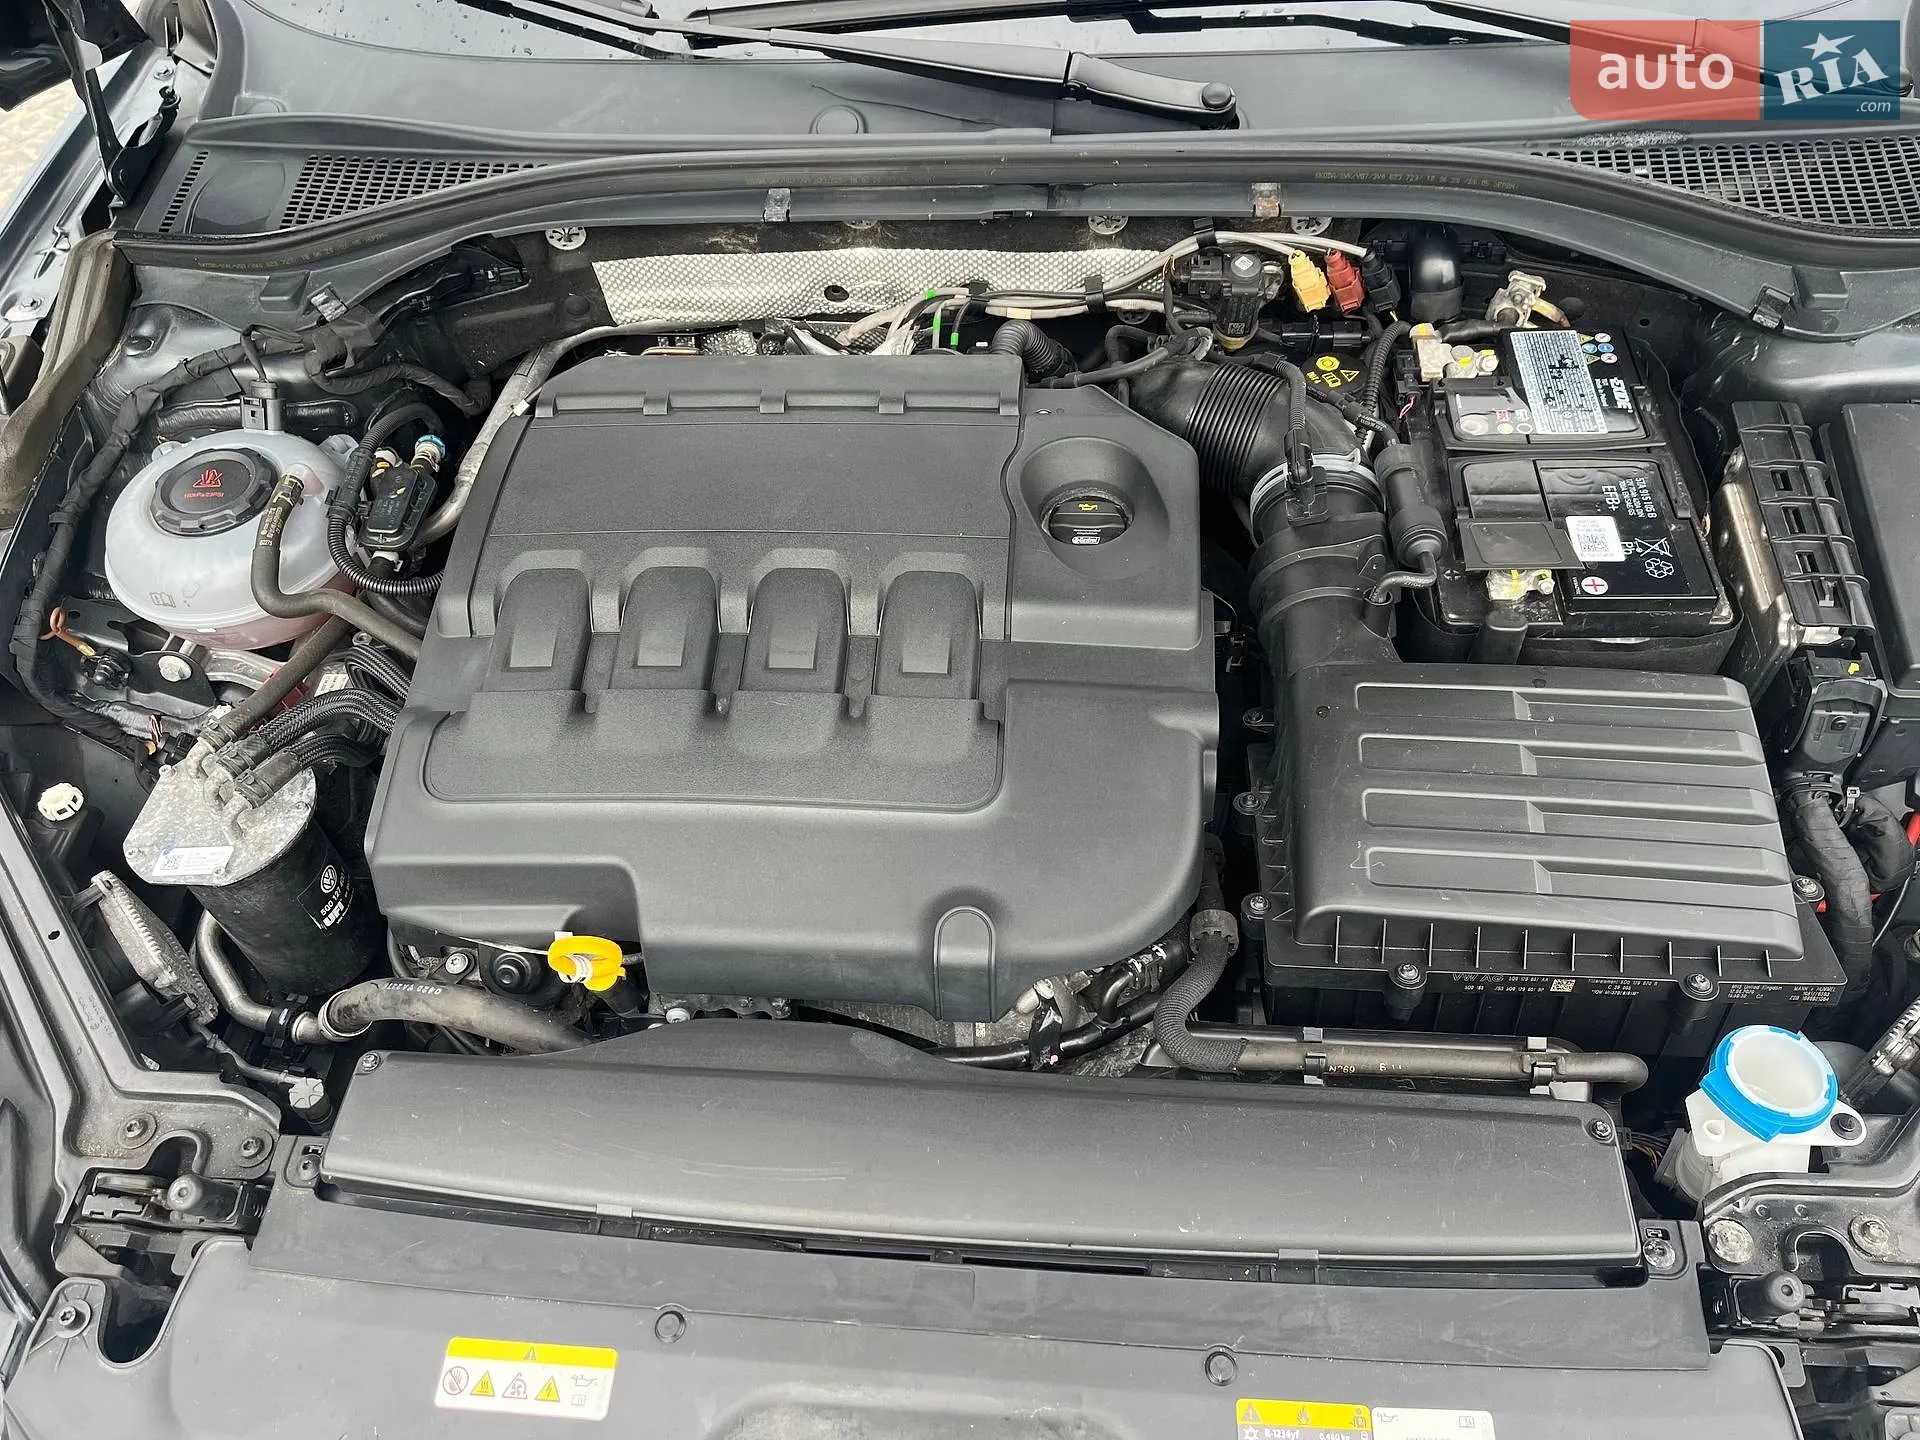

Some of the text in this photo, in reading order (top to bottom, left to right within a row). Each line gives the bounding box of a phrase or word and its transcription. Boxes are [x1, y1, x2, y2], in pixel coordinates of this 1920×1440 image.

[1609, 375, 1633, 409] EXIDE
[1601, 485, 1621, 511] EFB+
[324, 901, 344, 926] UFI
